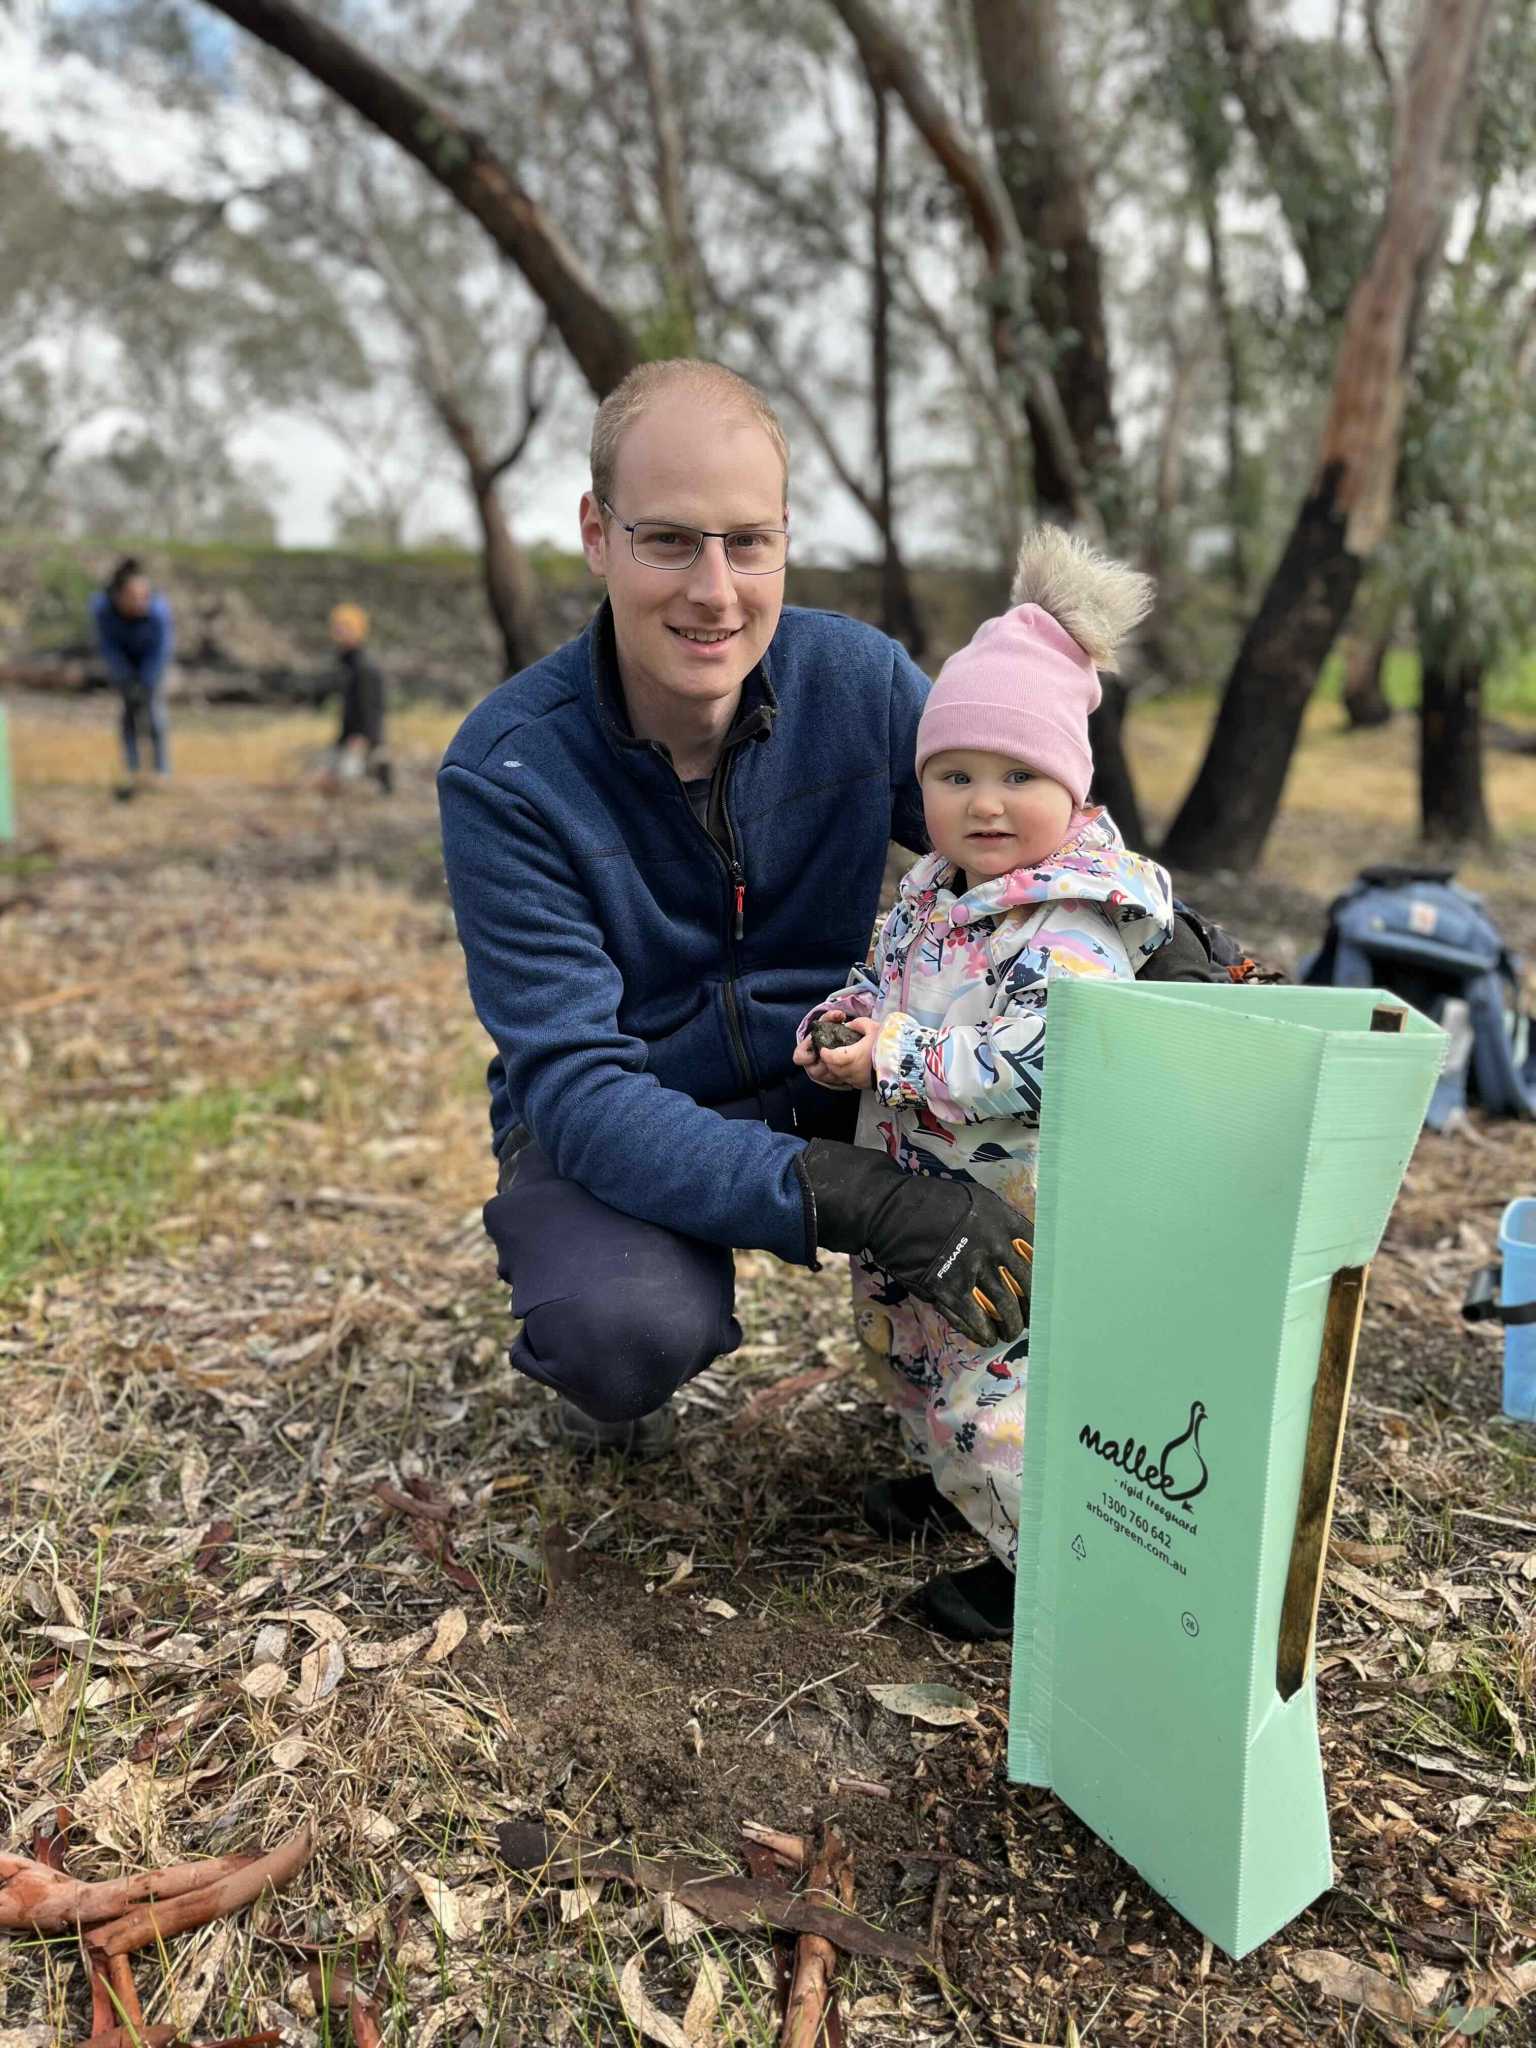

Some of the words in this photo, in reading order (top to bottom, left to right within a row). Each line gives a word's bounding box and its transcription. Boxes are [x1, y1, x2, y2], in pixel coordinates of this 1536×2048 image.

[937, 1237, 968, 1279] FISKARS
[1102, 1492, 1127, 1518] 1300
[1129, 1510, 1149, 1533] 760
[1151, 1526, 1172, 1549] 642
[1120, 1480, 1144, 1501] rigid
[1146, 1495, 1198, 1536] treeguard
[1086, 1501, 1187, 1576] arborgreen.com.au
